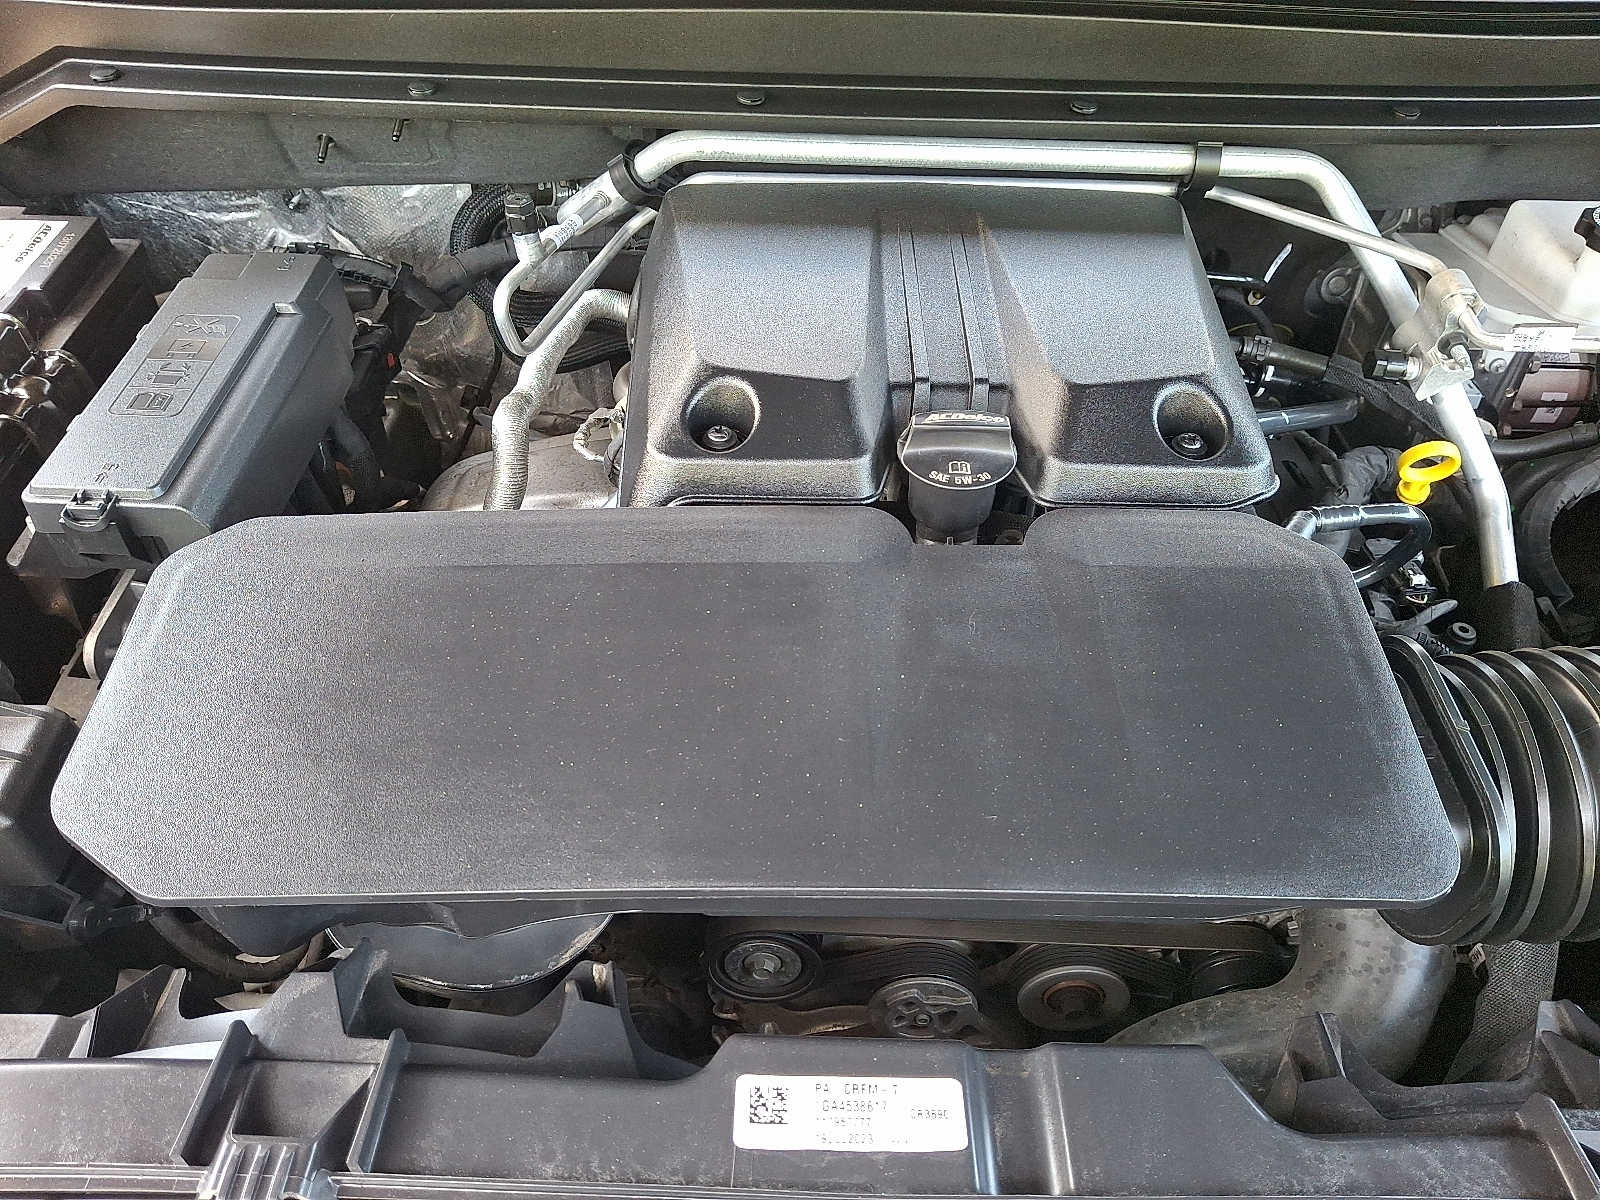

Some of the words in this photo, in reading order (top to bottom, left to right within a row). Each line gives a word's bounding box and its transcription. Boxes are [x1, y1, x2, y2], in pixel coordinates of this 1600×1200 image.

[923, 412, 1005, 425] ACDelco
[928, 470, 951, 483] SAE
[954, 471, 992, 485] 5W-30
